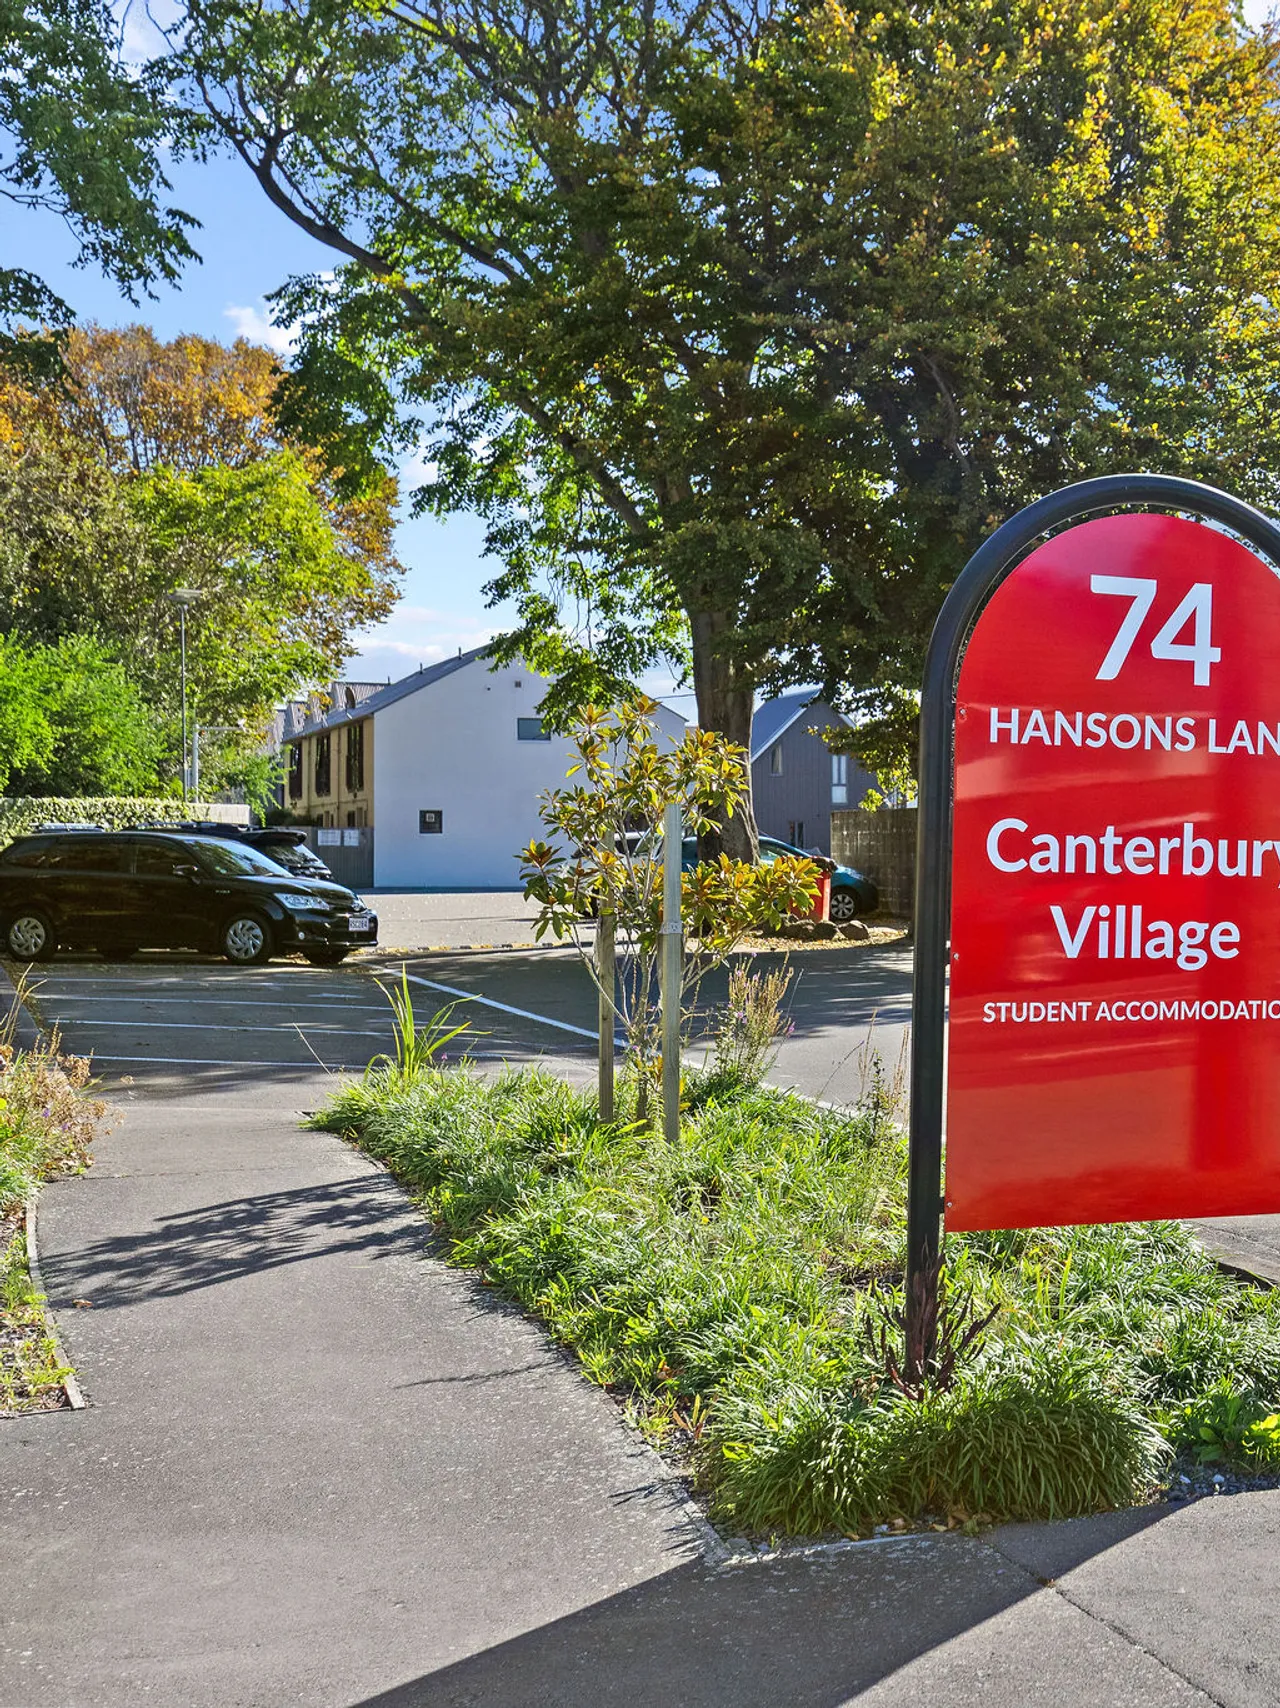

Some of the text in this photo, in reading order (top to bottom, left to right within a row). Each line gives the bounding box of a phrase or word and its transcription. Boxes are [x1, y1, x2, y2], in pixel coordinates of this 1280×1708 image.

[1090, 573, 1222, 687] 74
[989, 706, 1197, 753] HANSONS
[1050, 903, 1241, 971] Village
[982, 1001, 1092, 1023] STUDENT
